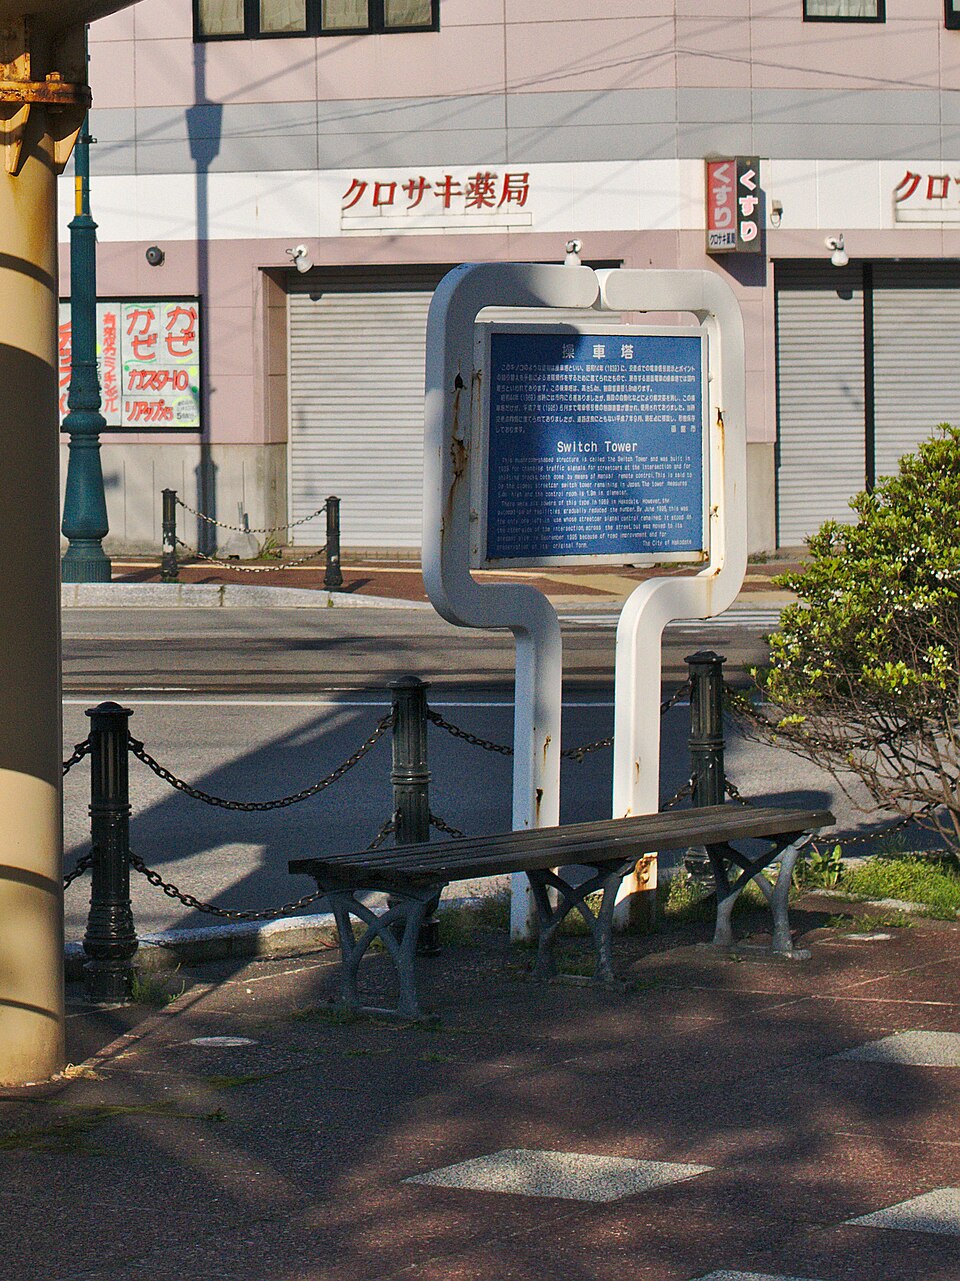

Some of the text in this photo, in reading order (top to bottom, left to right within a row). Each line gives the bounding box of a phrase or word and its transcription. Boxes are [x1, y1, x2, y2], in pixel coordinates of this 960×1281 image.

[342, 171, 529, 211] クロサキ薬局
[713, 163, 733, 228] くすり
[739, 169, 759, 242] くすり
[895, 170, 960, 204] クロ
[556, 441, 638, 453] Switch Tower
